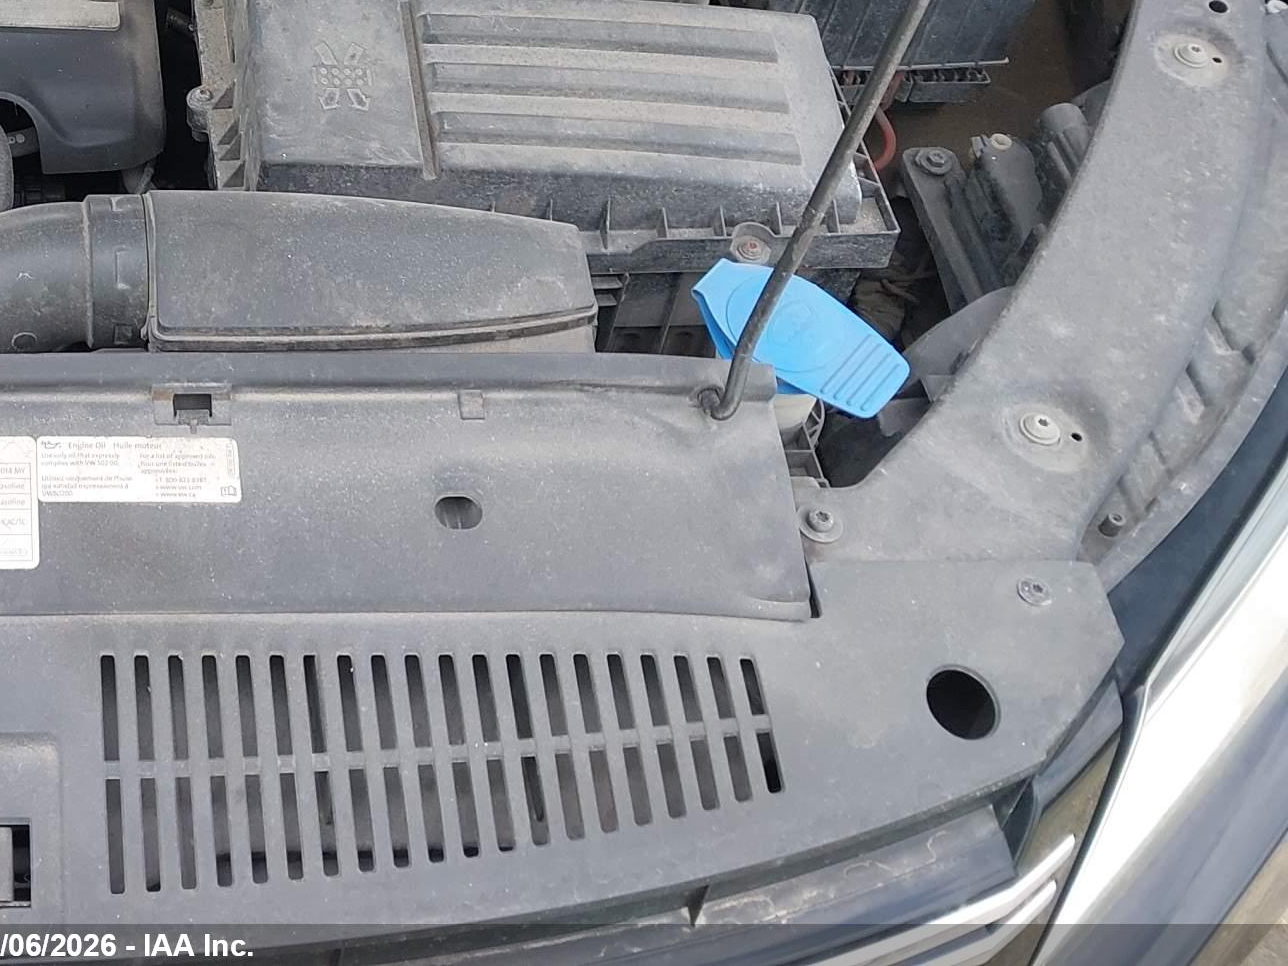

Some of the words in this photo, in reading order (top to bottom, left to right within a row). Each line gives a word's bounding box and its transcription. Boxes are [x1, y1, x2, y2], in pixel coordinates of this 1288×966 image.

[68, 441, 93, 451] Engine
[95, 441, 106, 450] Oil
[135, 442, 162, 450] moteur
